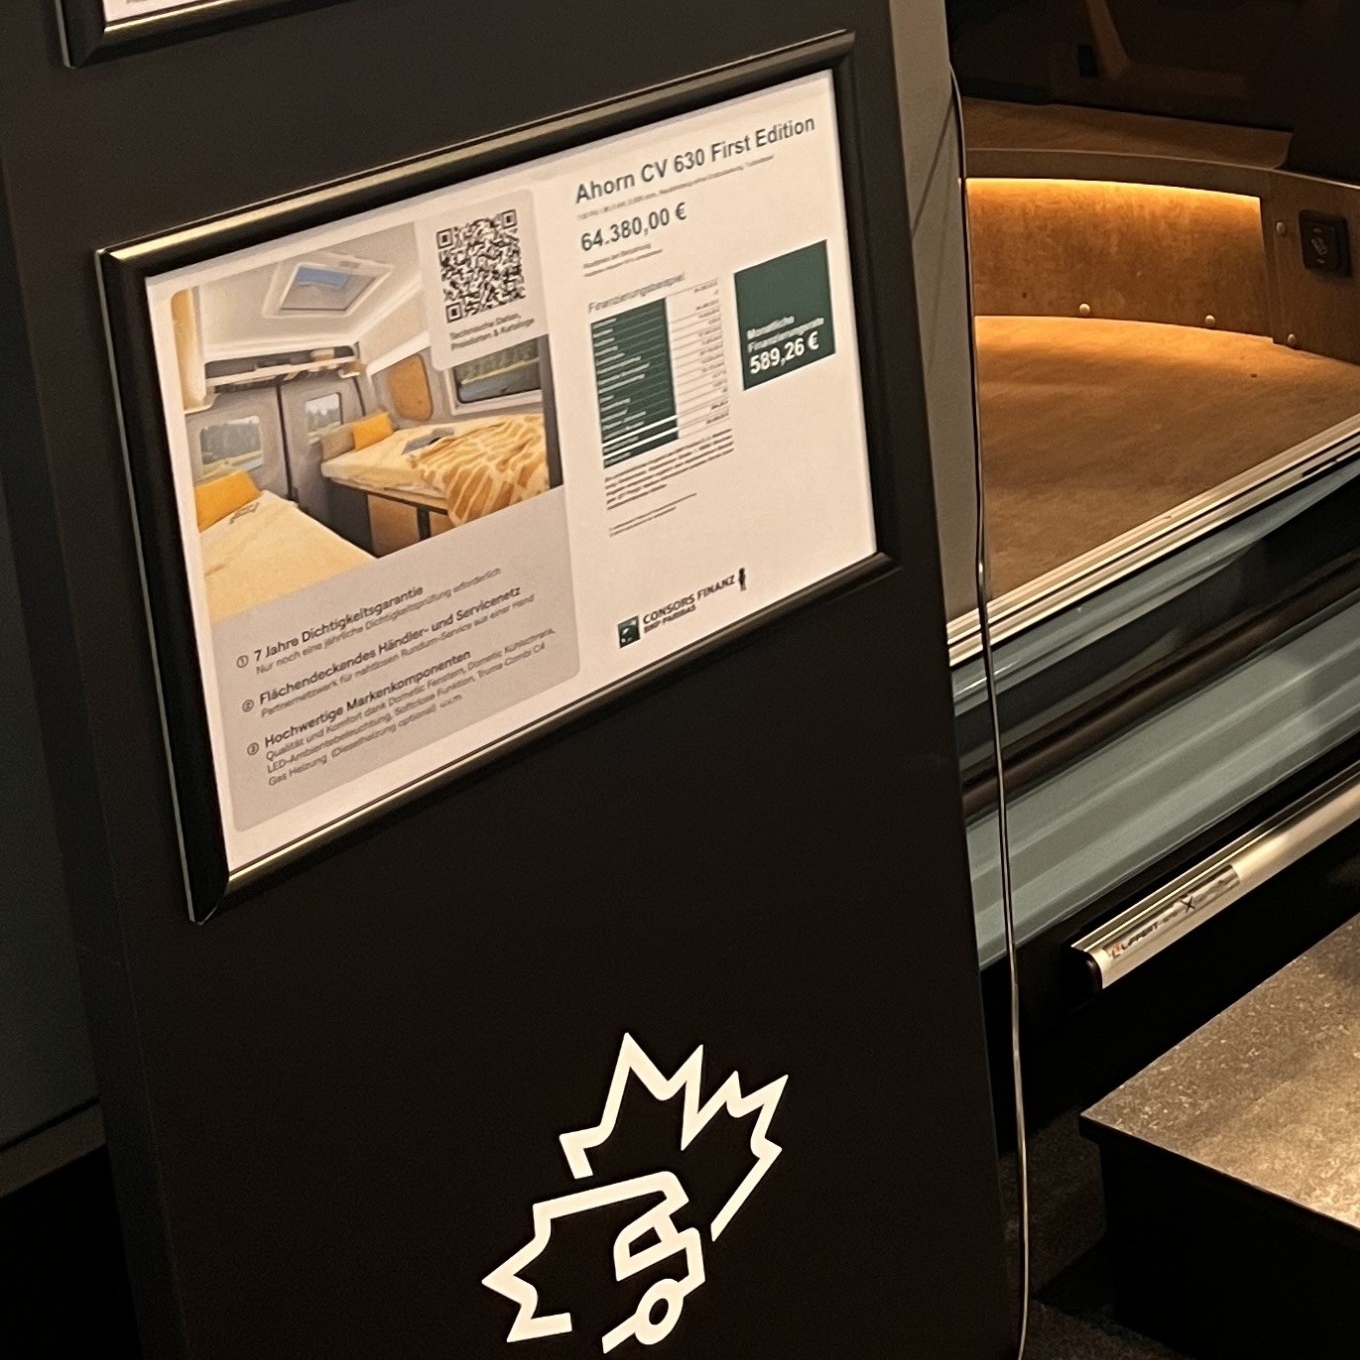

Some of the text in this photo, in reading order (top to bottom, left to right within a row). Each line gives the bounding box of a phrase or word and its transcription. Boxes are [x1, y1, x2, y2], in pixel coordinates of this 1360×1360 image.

[576, 118, 816, 204] Ahorn CV 630 First Edition
[581, 202, 687, 252] 64.380,00 €
[750, 330, 820, 375] 589,26 €
[253, 585, 424, 662] 7 Jahre Dichtigkeitsgarantie
[642, 574, 736, 625] CONSORS FINANZ
[260, 586, 521, 706] Flächendeckendes Händler- und Servicenetz
[264, 650, 472, 748] Hochwertige Markenkomponenten
